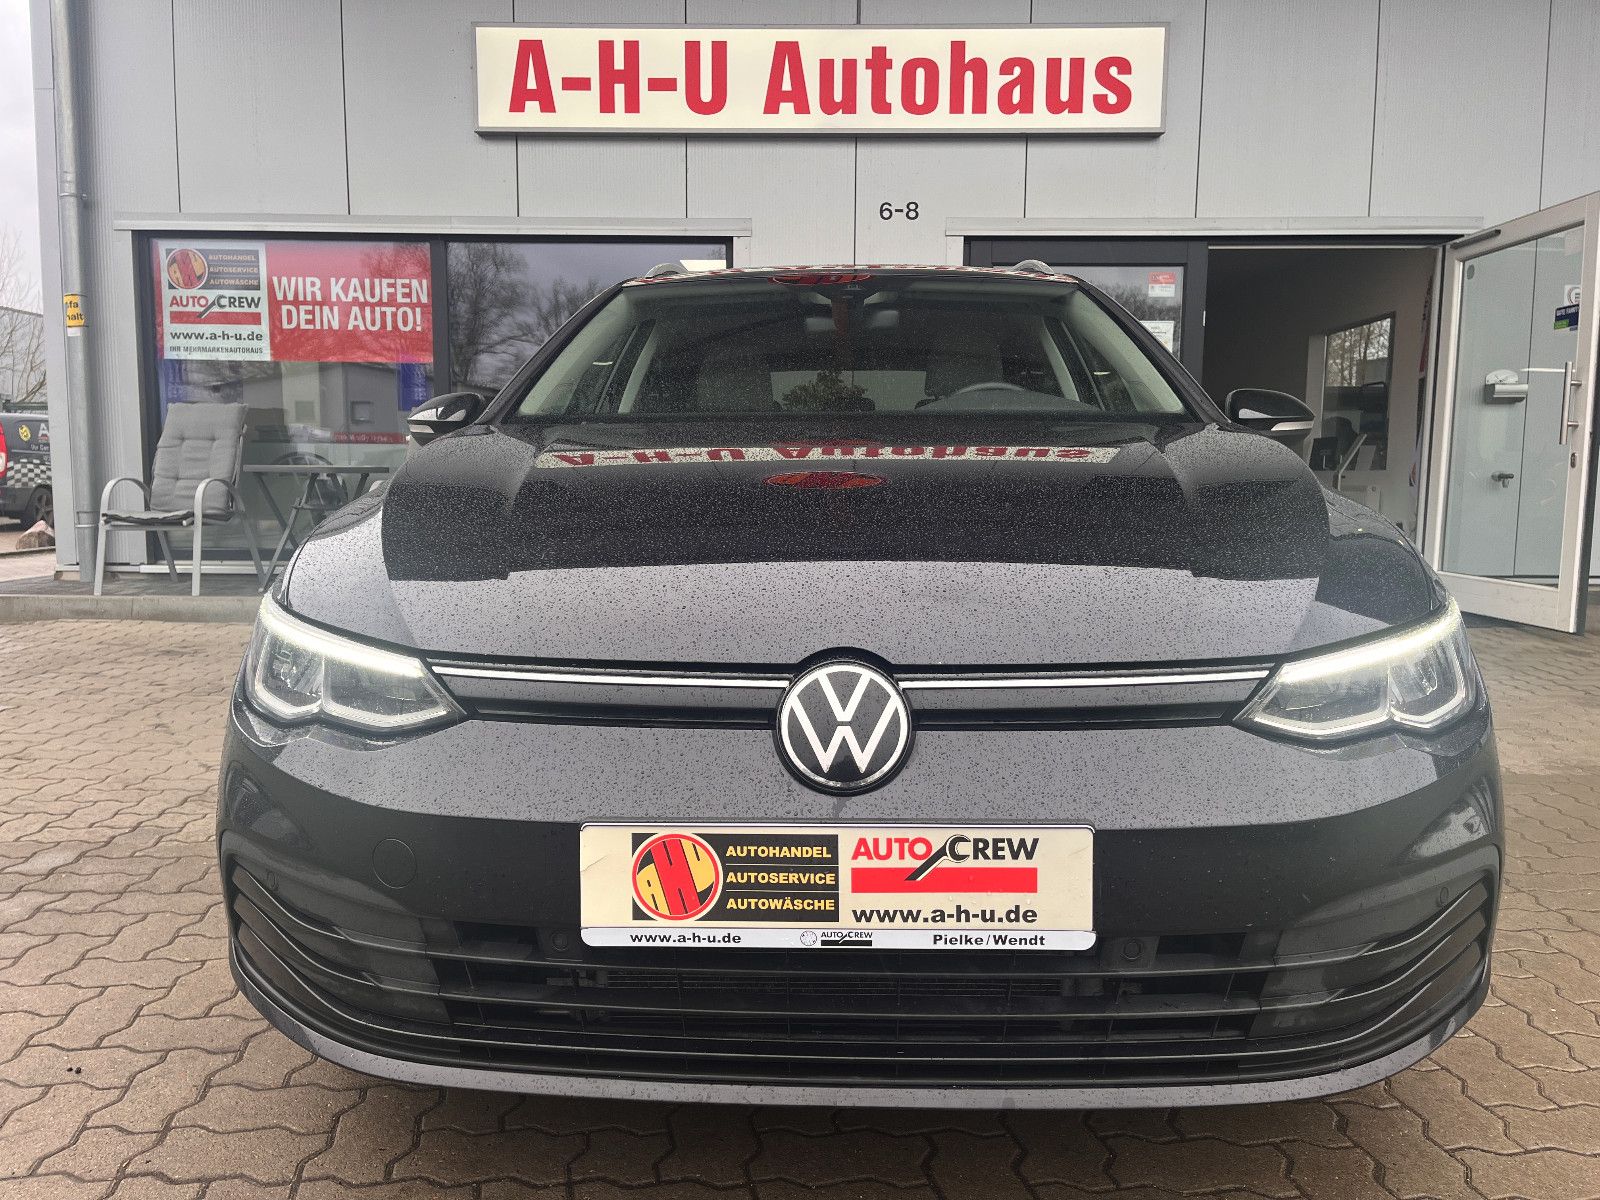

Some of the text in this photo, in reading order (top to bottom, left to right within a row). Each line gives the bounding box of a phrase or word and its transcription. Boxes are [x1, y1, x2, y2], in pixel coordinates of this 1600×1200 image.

[508, 39, 1132, 116] A-H-U Autohaus
[878, 202, 920, 221] 6-8
[208, 266, 259, 274] AUTOSERVICE
[271, 276, 428, 304] WIR KAUFEN
[281, 304, 422, 332] DEIN AUTO!
[169, 331, 263, 342] www.a-h-u.de
[169, 345, 264, 354] IHR MEHRMARKENAUTOHAUS
[725, 845, 832, 859] AUTOHANDEL
[725, 871, 836, 885] AUTOSERVICE
[725, 896, 836, 911] AUTOWÄSCHE
[851, 904, 1038, 924] www.a-h-u.de
[629, 932, 742, 944] www.a-h-u.de
